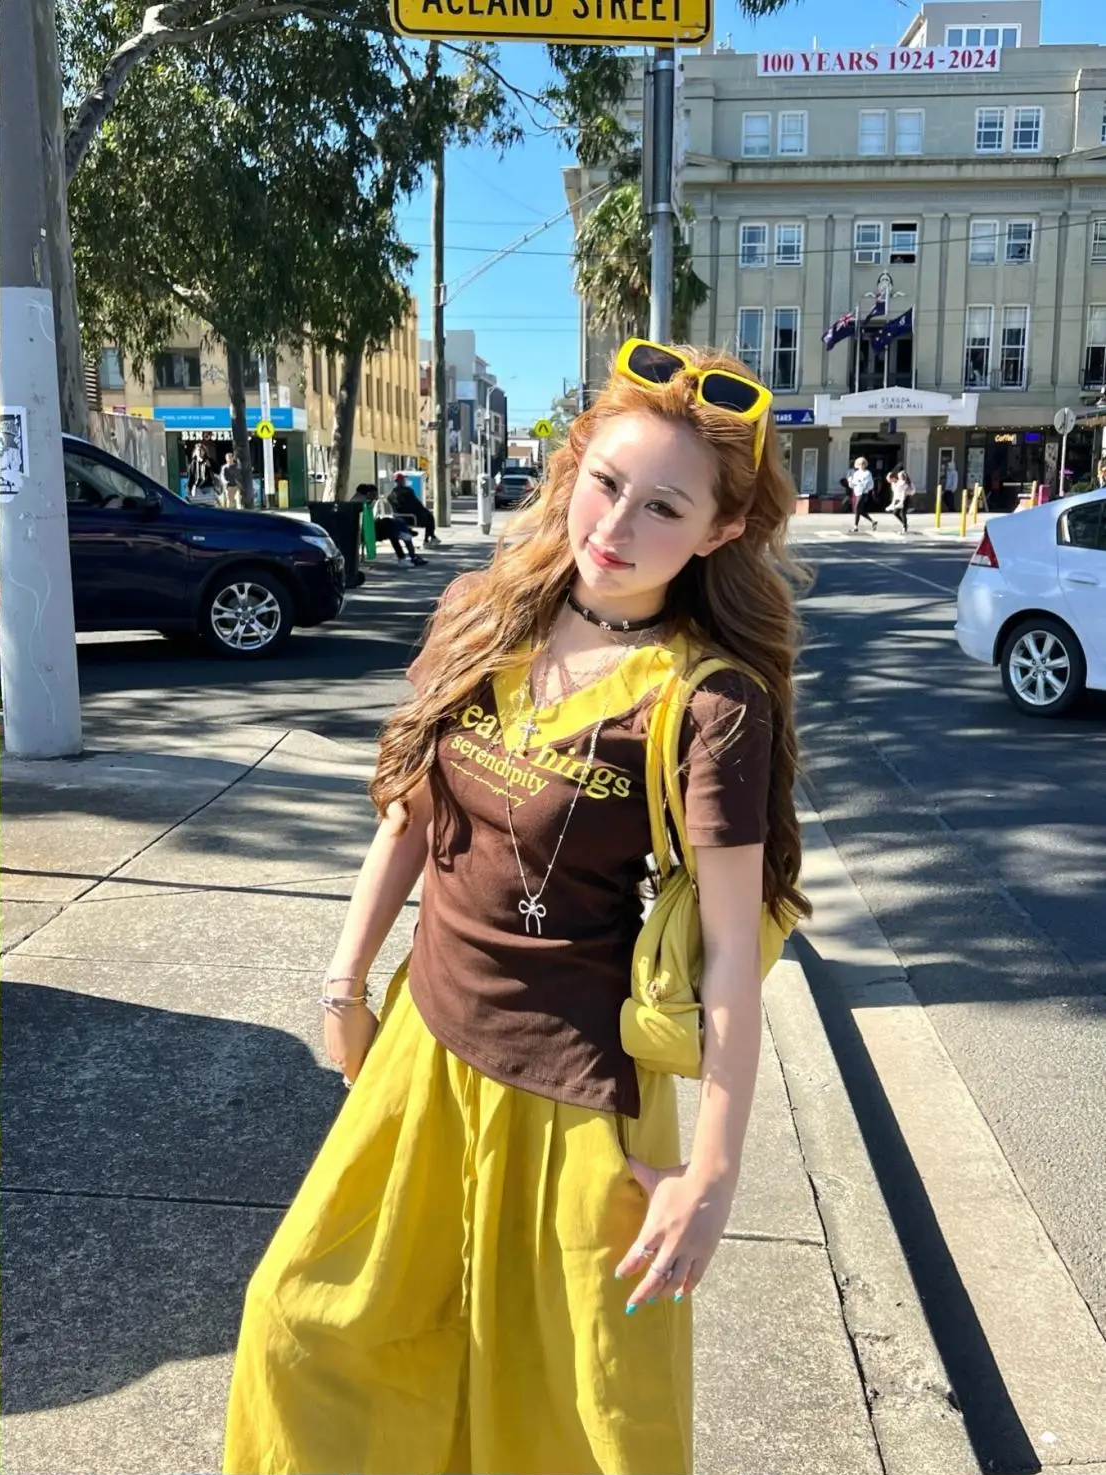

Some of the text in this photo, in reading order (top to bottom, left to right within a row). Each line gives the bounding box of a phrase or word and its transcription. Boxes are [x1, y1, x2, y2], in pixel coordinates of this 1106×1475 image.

[761, 52, 794, 73] 100
[800, 51, 879, 72] YEARS
[181, 431, 203, 441] BEN
[450, 733, 550, 796] serendipity
